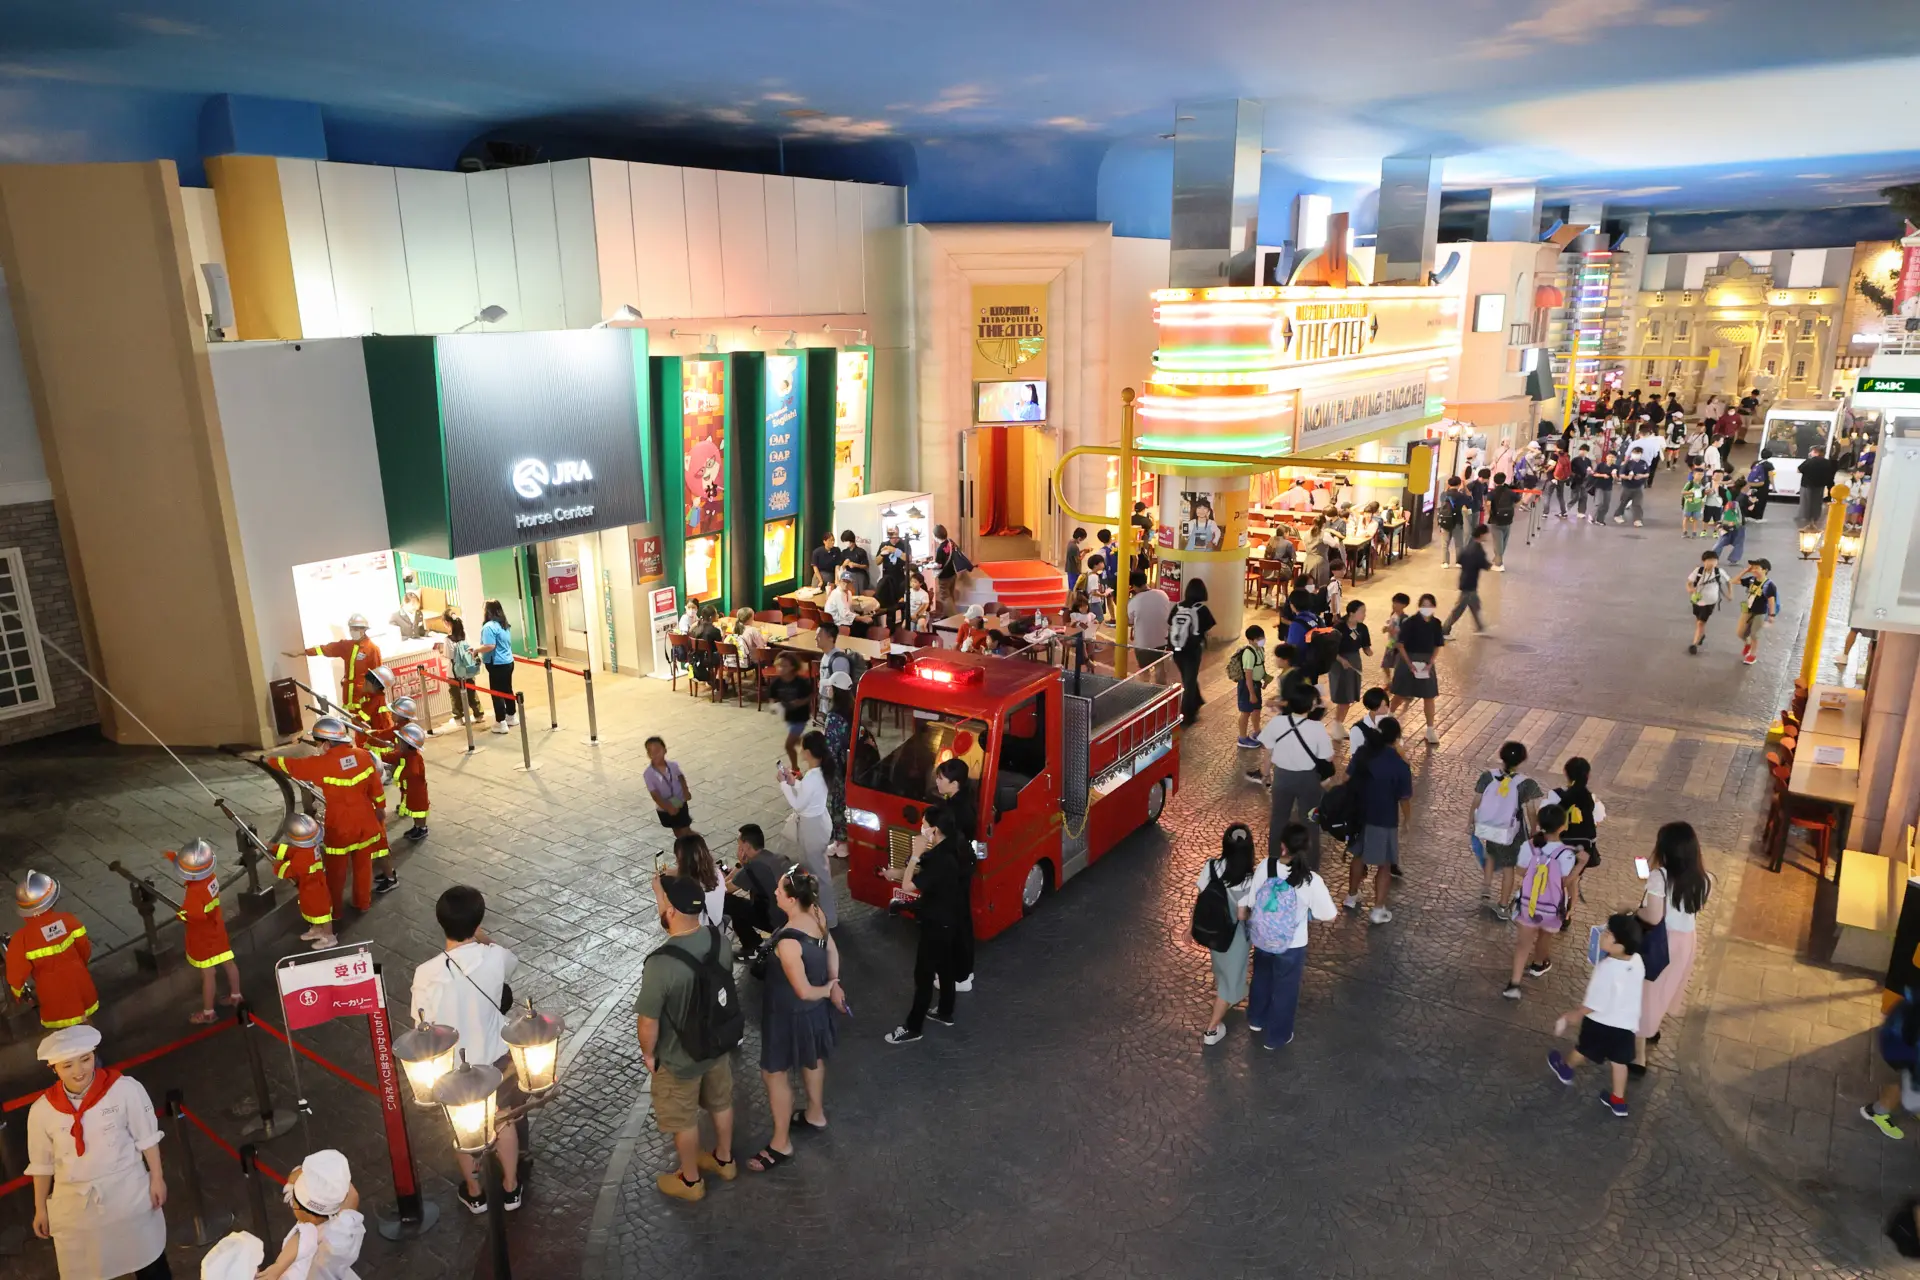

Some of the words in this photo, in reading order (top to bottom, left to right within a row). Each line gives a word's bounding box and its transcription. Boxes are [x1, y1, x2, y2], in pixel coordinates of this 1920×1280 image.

[977, 324, 1043, 338] THEATER
[1296, 321, 1366, 360] THEATER
[1874, 381, 1905, 391] SMBC
[1303, 401, 1333, 432] NOW
[1335, 392, 1382, 424] PLAYING
[1384, 384, 1423, 411] ENCORE
[552, 459, 593, 485] JRA
[516, 513, 553, 528] Horse
[554, 505, 595, 521] Center
[335, 961, 367, 978] 受付
[333, 998, 372, 1008] ベーカリー
[373, 1011, 397, 1110] こちらからお並びください
